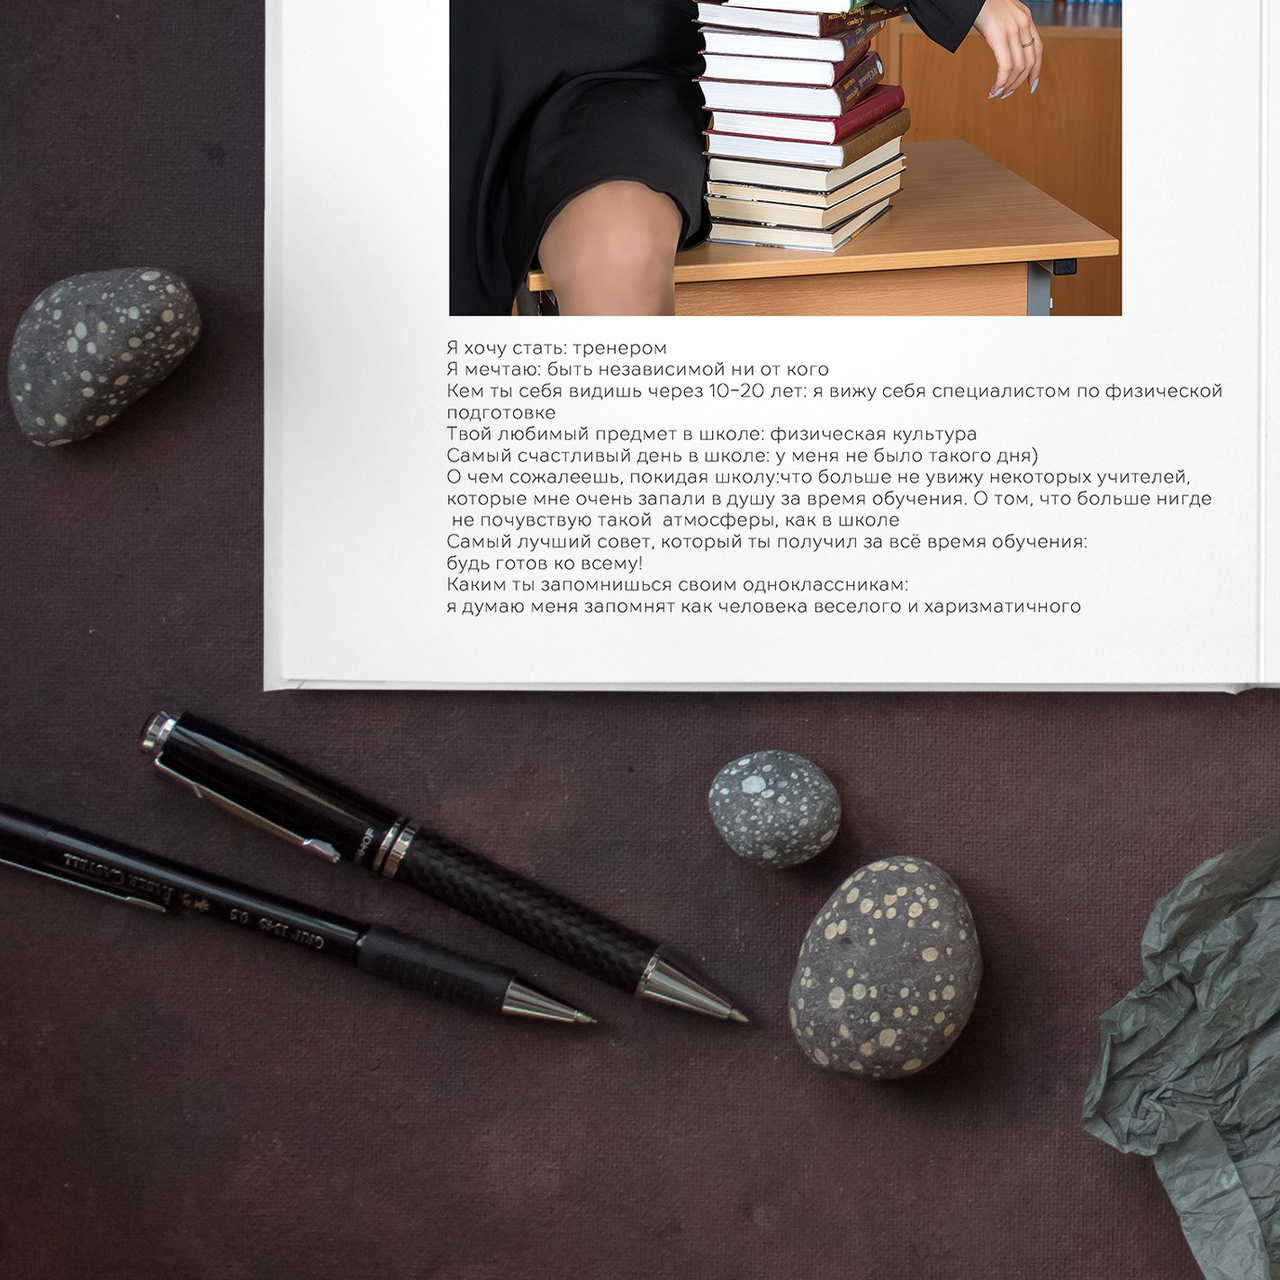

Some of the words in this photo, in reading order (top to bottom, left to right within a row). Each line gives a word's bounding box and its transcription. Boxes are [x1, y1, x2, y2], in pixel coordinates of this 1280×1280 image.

[446, 339, 458, 355] Я
[464, 343, 508, 359] хочу
[512, 343, 567, 356] стать:
[572, 343, 667, 359] тренером
[446, 361, 458, 377] Я
[465, 364, 541, 377] мечтаю:
[547, 360, 593, 377] быть
[598, 361, 725, 377] независимой
[731, 364, 755, 376] ни
[760, 364, 781, 377] от
[787, 364, 830, 377] кого
[447, 383, 484, 399] Кем
[489, 386, 513, 398] ты
[518, 382, 562, 399] себя
[569, 386, 643, 401] видишь
[648, 386, 704, 402] через
[770, 386, 807, 399] лет:
[812, 386, 823, 398] я
[829, 386, 878, 402] вижу
[882, 382, 926, 399] себя
[931, 386, 1070, 401] специалистом
[1077, 386, 1100, 399] по
[1105, 382, 1223, 402] физической
[447, 407, 556, 423] подготовке
[446, 425, 492, 442] Твой
[497, 425, 589, 442] любимый
[595, 428, 678, 445] предмет
[683, 429, 693, 441] в
[699, 428, 765, 442] школе:
[770, 426, 886, 445] физическая
[893, 428, 977, 445] культура
[446, 447, 512, 463] Самый
[517, 447, 631, 463] счастливый
[636, 450, 683, 466] день
[688, 451, 699, 463] в
[704, 450, 770, 463] школе:
[775, 451, 786, 467] у
[792, 450, 839, 463] меня
[846, 450, 868, 463] не
[873, 446, 923, 463] было
[928, 450, 992, 464] такого
[996, 446, 1039, 467] дня)
[446, 468, 462, 485] О
[467, 471, 504, 485] чем
[509, 471, 624, 486] сожалеешь,
[630, 471, 708, 487] покидая
[818, 468, 892, 485] больше
[897, 471, 920, 485] не
[925, 472, 984, 488] увижу
[990, 471, 1092, 488] некоторых
[1096, 468, 1190, 488] учителей,
[447, 493, 528, 509] которые
[533, 493, 570, 506] мне
[575, 493, 633, 506] очень
[637, 493, 705, 506] запали
[712, 493, 722, 506] в
[726, 493, 776, 510] душу
[780, 493, 801, 506] за
[807, 493, 866, 509] время
[872, 489, 968, 510] обучения.
[973, 490, 989, 506] О
[993, 493, 1034, 508] том,
[1039, 493, 1072, 506] что
[1076, 489, 1151, 506] больше
[1156, 493, 1212, 509] нигде
[452, 515, 475, 528] не
[480, 515, 592, 531] почувствую
[597, 511, 652, 528] такой
[662, 511, 779, 531] атмосферы,
[785, 515, 817, 528] как
[822, 515, 833, 527] в
[838, 515, 900, 528] школе
[446, 533, 512, 549] Самый
[516, 533, 591, 553] лучший
[597, 536, 655, 551] совет,
[661, 533, 742, 552] который
[747, 536, 771, 549] ты
[777, 536, 857, 553] получил
[863, 536, 883, 549] за
[889, 533, 922, 549] всё
[927, 536, 986, 552] время
[992, 533, 1088, 553] обучения:
[446, 554, 491, 575] будь
[496, 558, 548, 571] готов
[554, 558, 576, 571] ко
[581, 555, 643, 575] всему!
[447, 576, 506, 592] Каким
[511, 579, 535, 592] ты
[540, 579, 672, 592] запомнишься
[678, 579, 737, 592] своим
[742, 579, 909, 594] одноклассникам:
[446, 601, 457, 614] я
[461, 601, 525, 618] думаю
[531, 601, 578, 614] меня
[584, 601, 676, 614] запомнят
[681, 601, 713, 614] как
[718, 601, 808, 614] человека
[814, 601, 902, 614] веселого
[908, 602, 919, 613] и
[924, 601, 1082, 617] харизматичного
[258, 917, 289, 938] 1345
